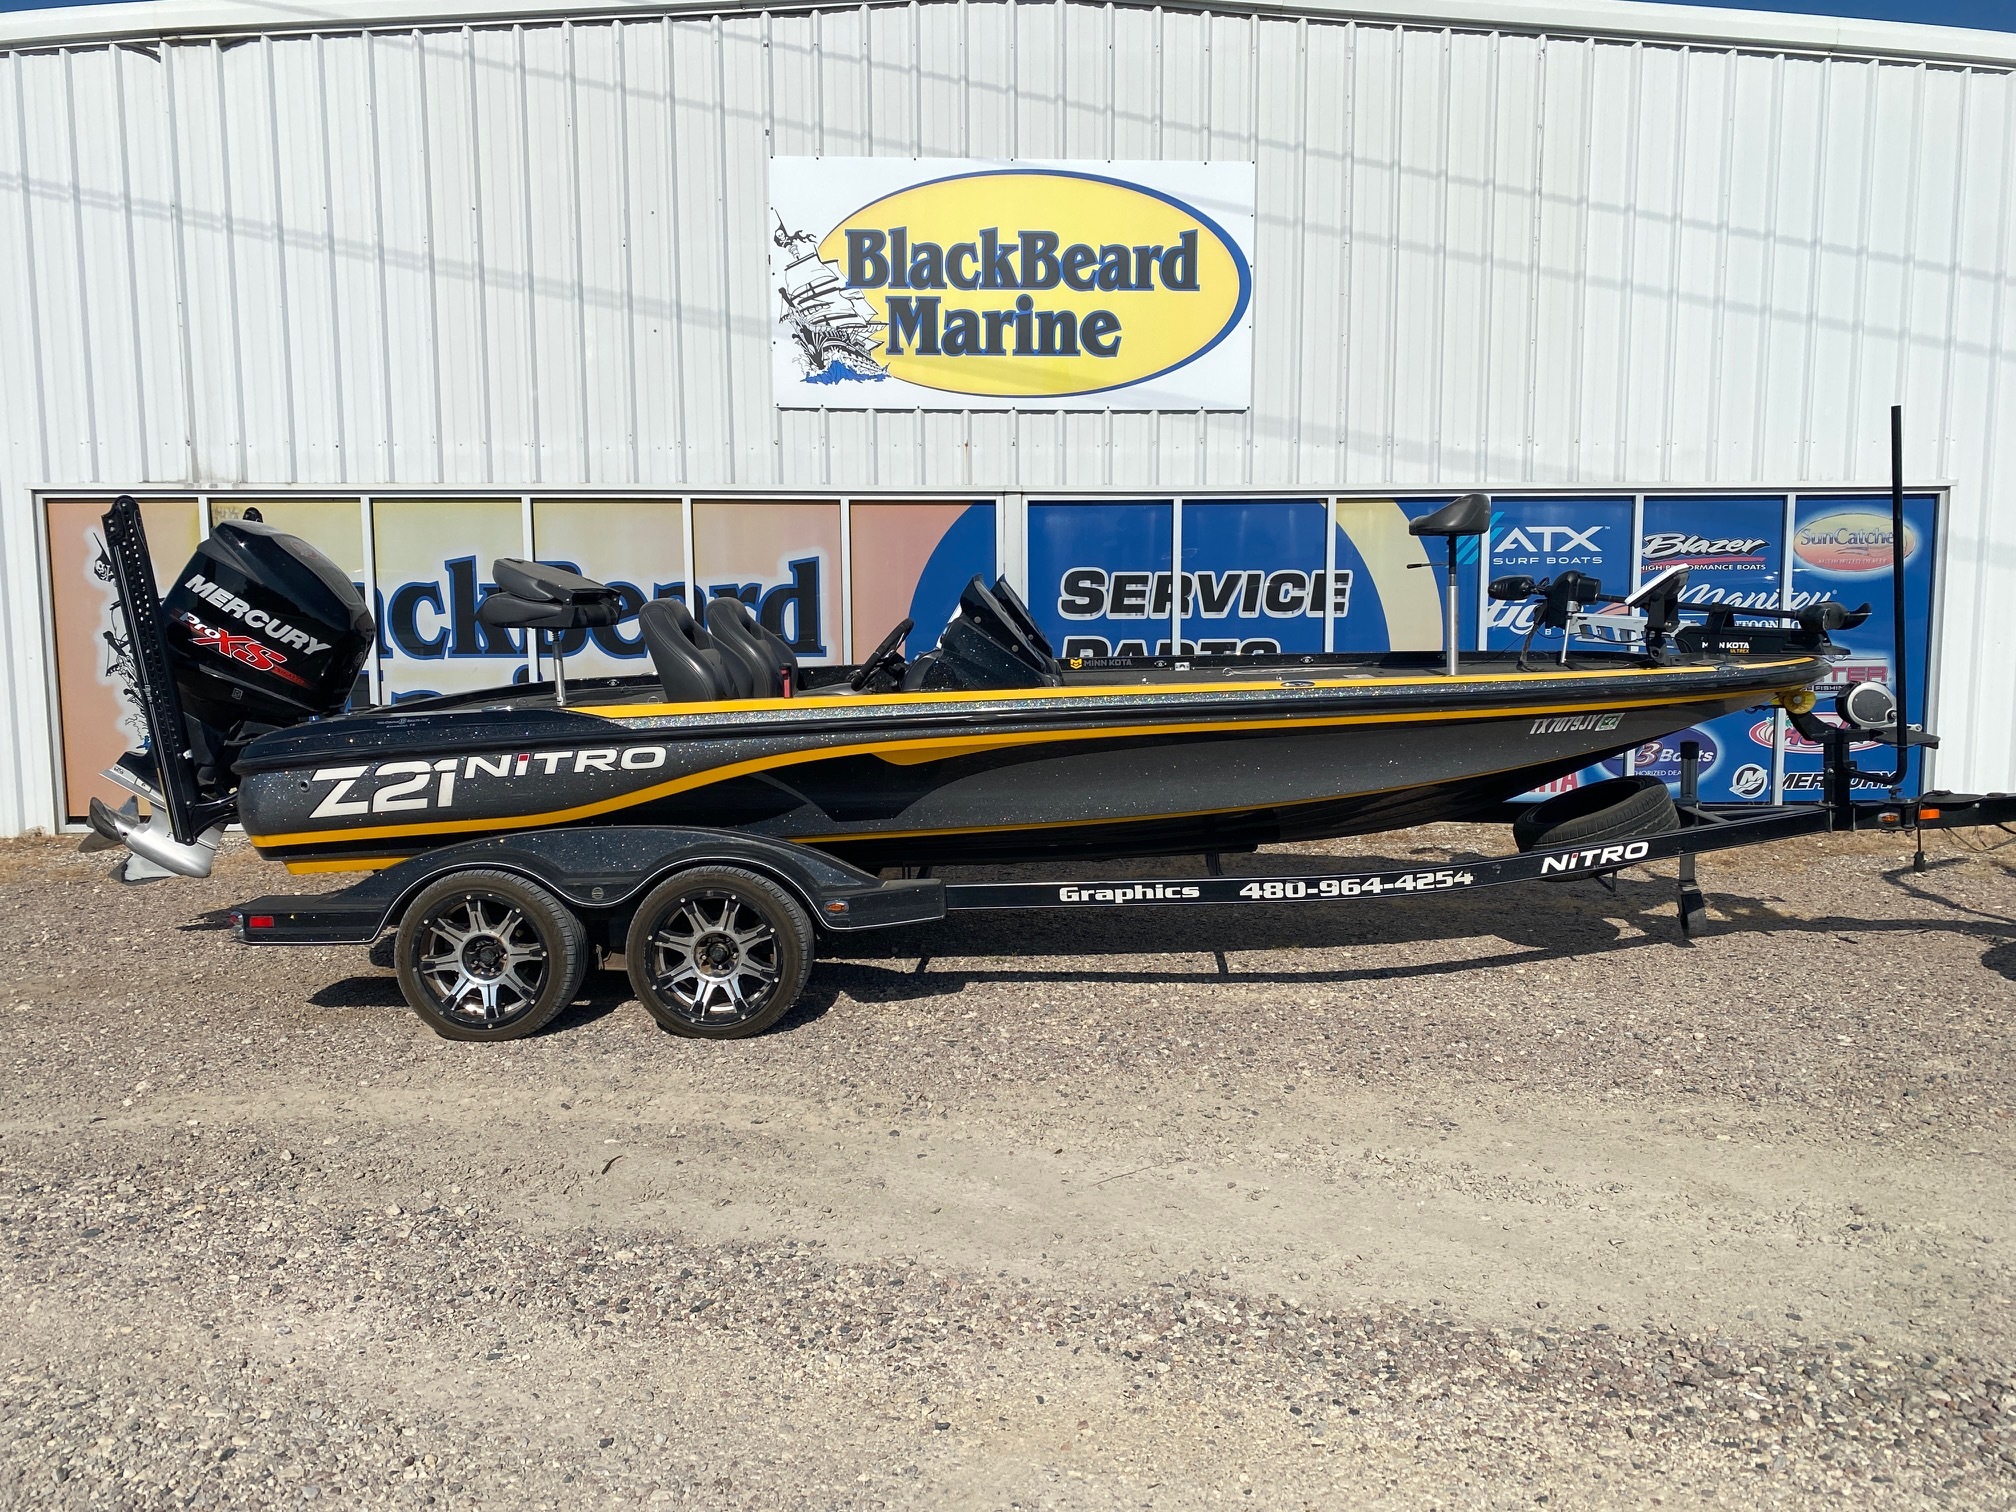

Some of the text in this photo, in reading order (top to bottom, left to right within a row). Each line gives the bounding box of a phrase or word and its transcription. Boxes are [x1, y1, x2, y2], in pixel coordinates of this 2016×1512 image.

[844, 226, 1200, 292] BlackBeard
[885, 293, 1122, 358] Marine
[1493, 526, 1604, 553] ATX
[1642, 532, 1770, 560] Blazer
[1800, 527, 1894, 546] SunCatche
[1493, 556, 1603, 565] SURF BOATS
[1057, 567, 1354, 620] SERVICE
[184, 573, 332, 655] MERCURY
[1658, 748, 1715, 763] Bots
[308, 758, 458, 819] Z21
[1059, 870, 1474, 904] Graphics 480-964-4254
